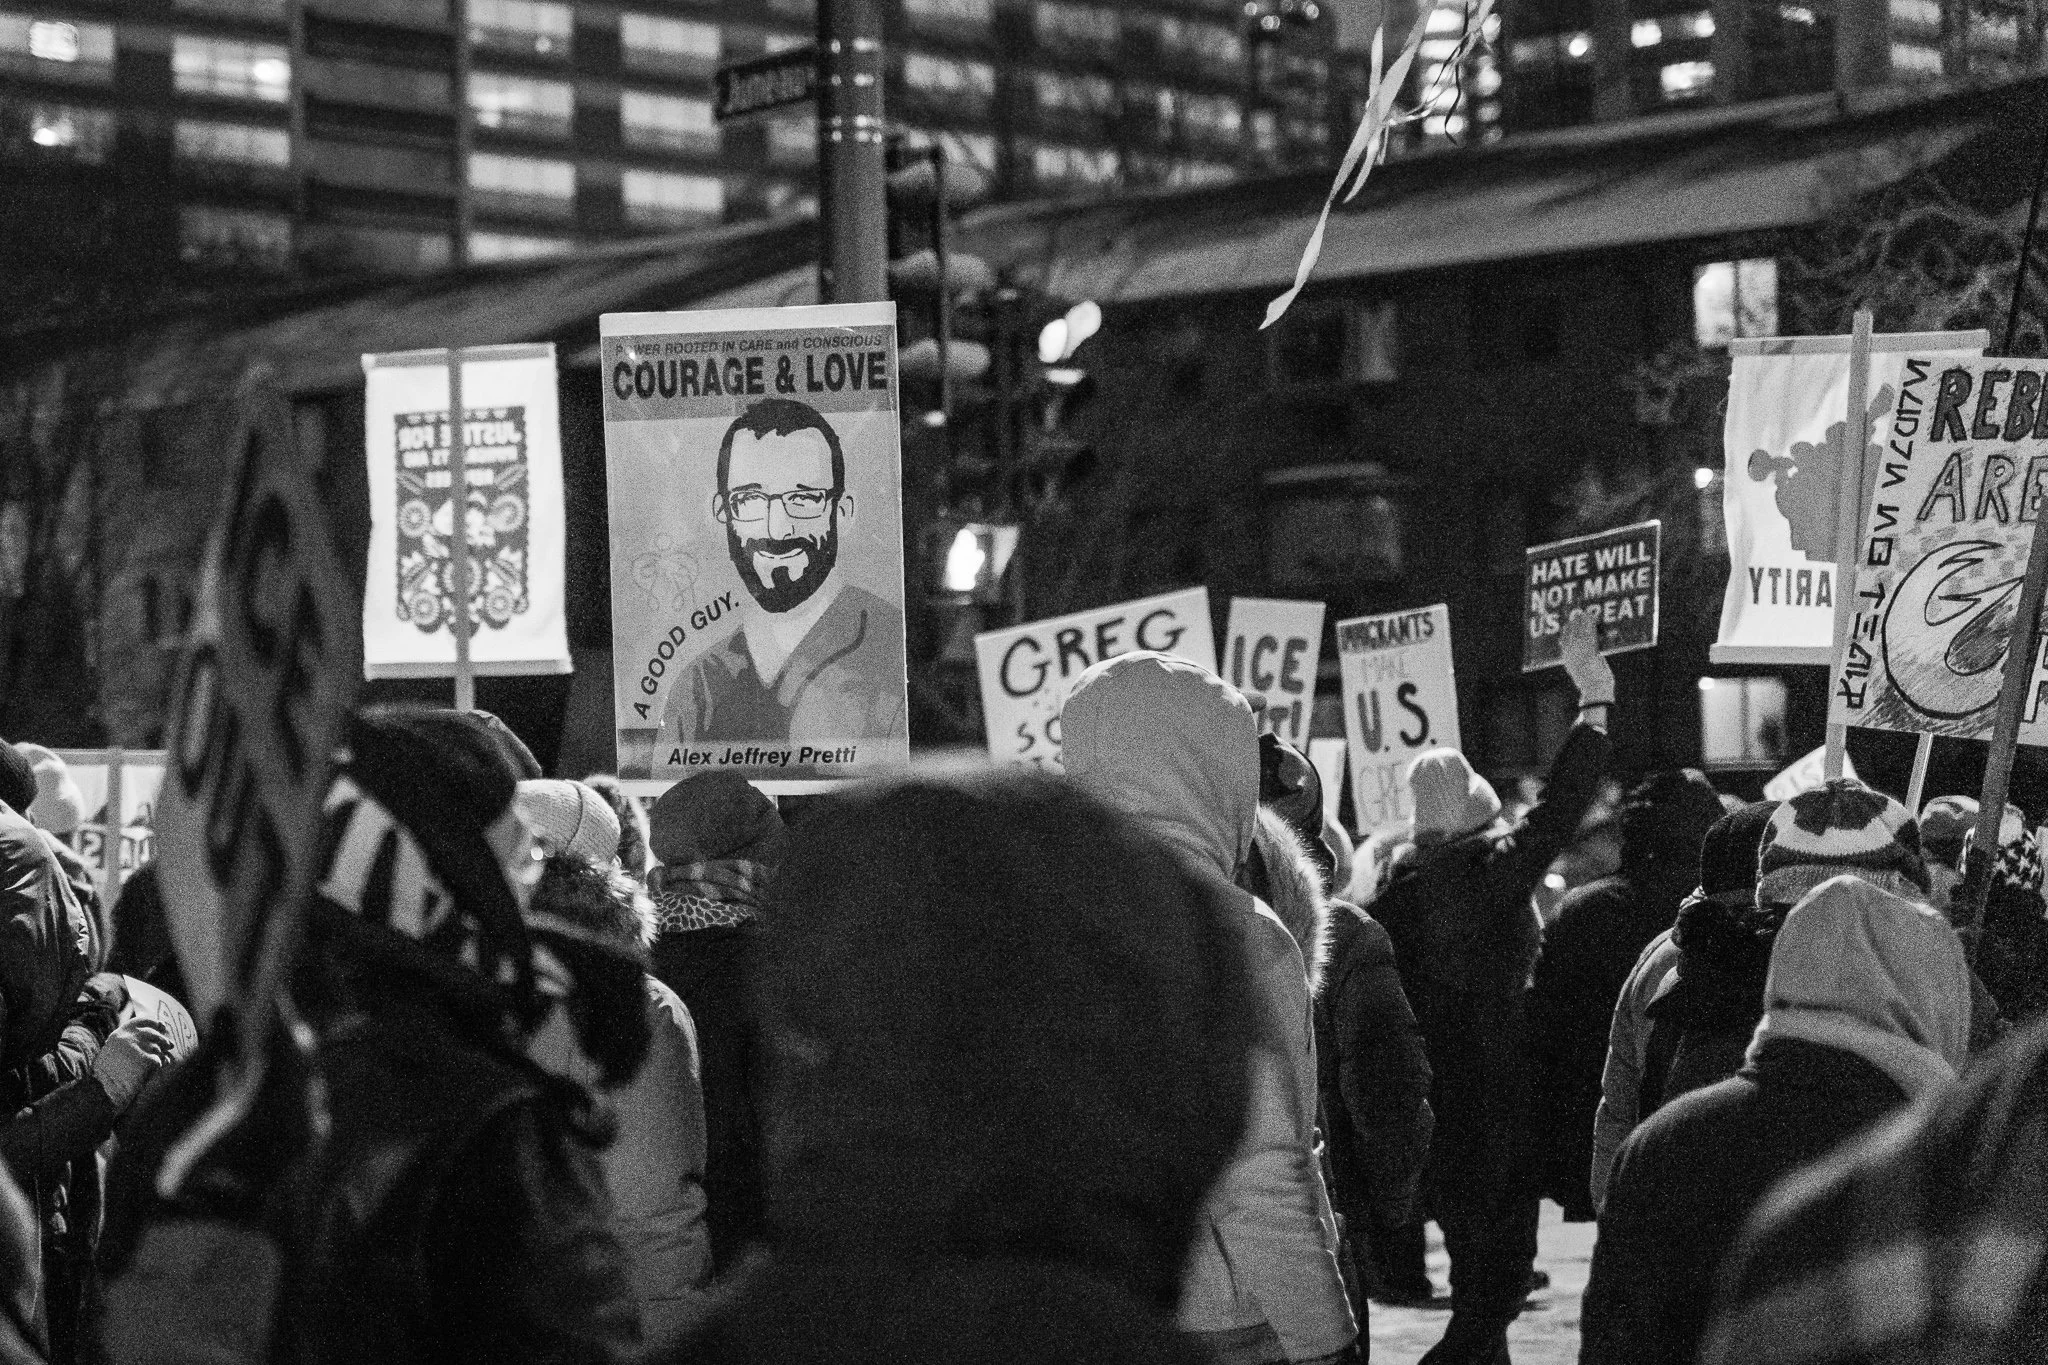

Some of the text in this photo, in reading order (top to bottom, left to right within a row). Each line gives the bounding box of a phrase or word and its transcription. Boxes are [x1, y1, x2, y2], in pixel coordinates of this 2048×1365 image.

[665, 341, 720, 355] ROOTED
[722, 341, 736, 354] IN
[739, 338, 773, 353] CARE
[776, 337, 798, 350] and
[803, 334, 882, 349] CONSCIOUS
[612, 350, 888, 401] COURAGE & LOVE
[1531, 540, 1651, 585] HATE WILL
[1531, 566, 1651, 613] NOT MAKE
[1529, 612, 1561, 639] US
[633, 590, 740, 721] A GOOD GUY.
[1000, 608, 1188, 698] GREG
[1232, 633, 1309, 695] ICE
[1357, 681, 1438, 754] U.S.
[667, 745, 857, 768] Alex Jeffrey Pretti
